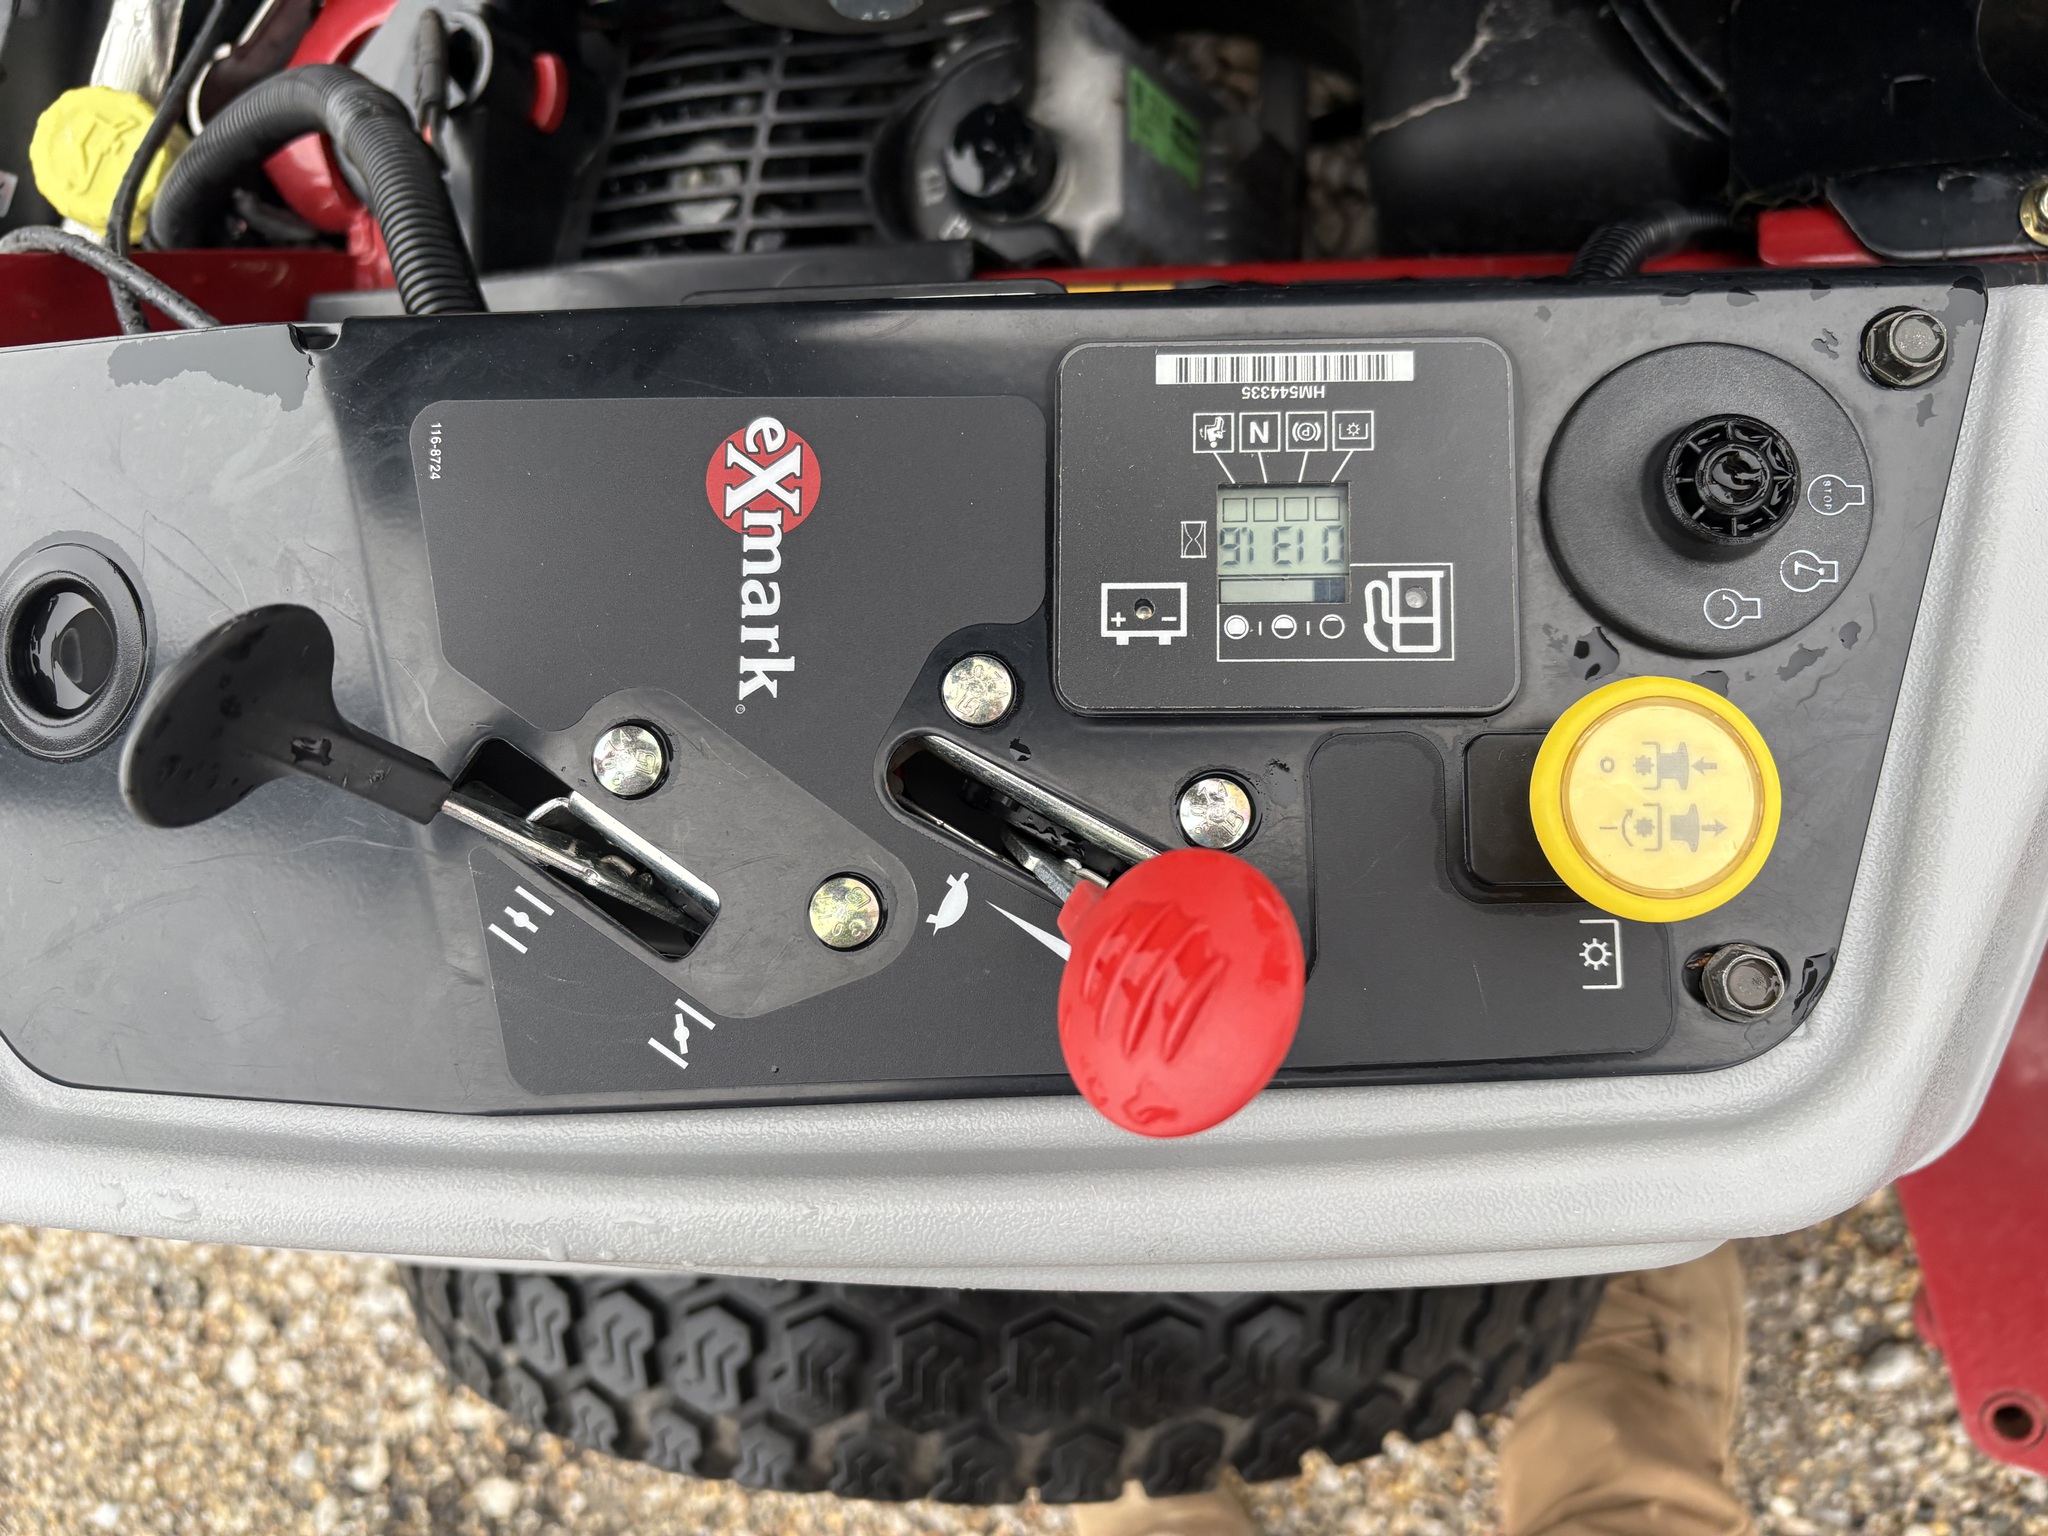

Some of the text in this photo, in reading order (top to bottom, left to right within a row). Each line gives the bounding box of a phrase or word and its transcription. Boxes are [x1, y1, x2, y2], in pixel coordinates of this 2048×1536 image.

[1241, 385, 1325, 399] HM544335
[1250, 421, 1269, 443] N
[429, 422, 442, 480] 116-8724
[1822, 479, 1833, 511] STOP
